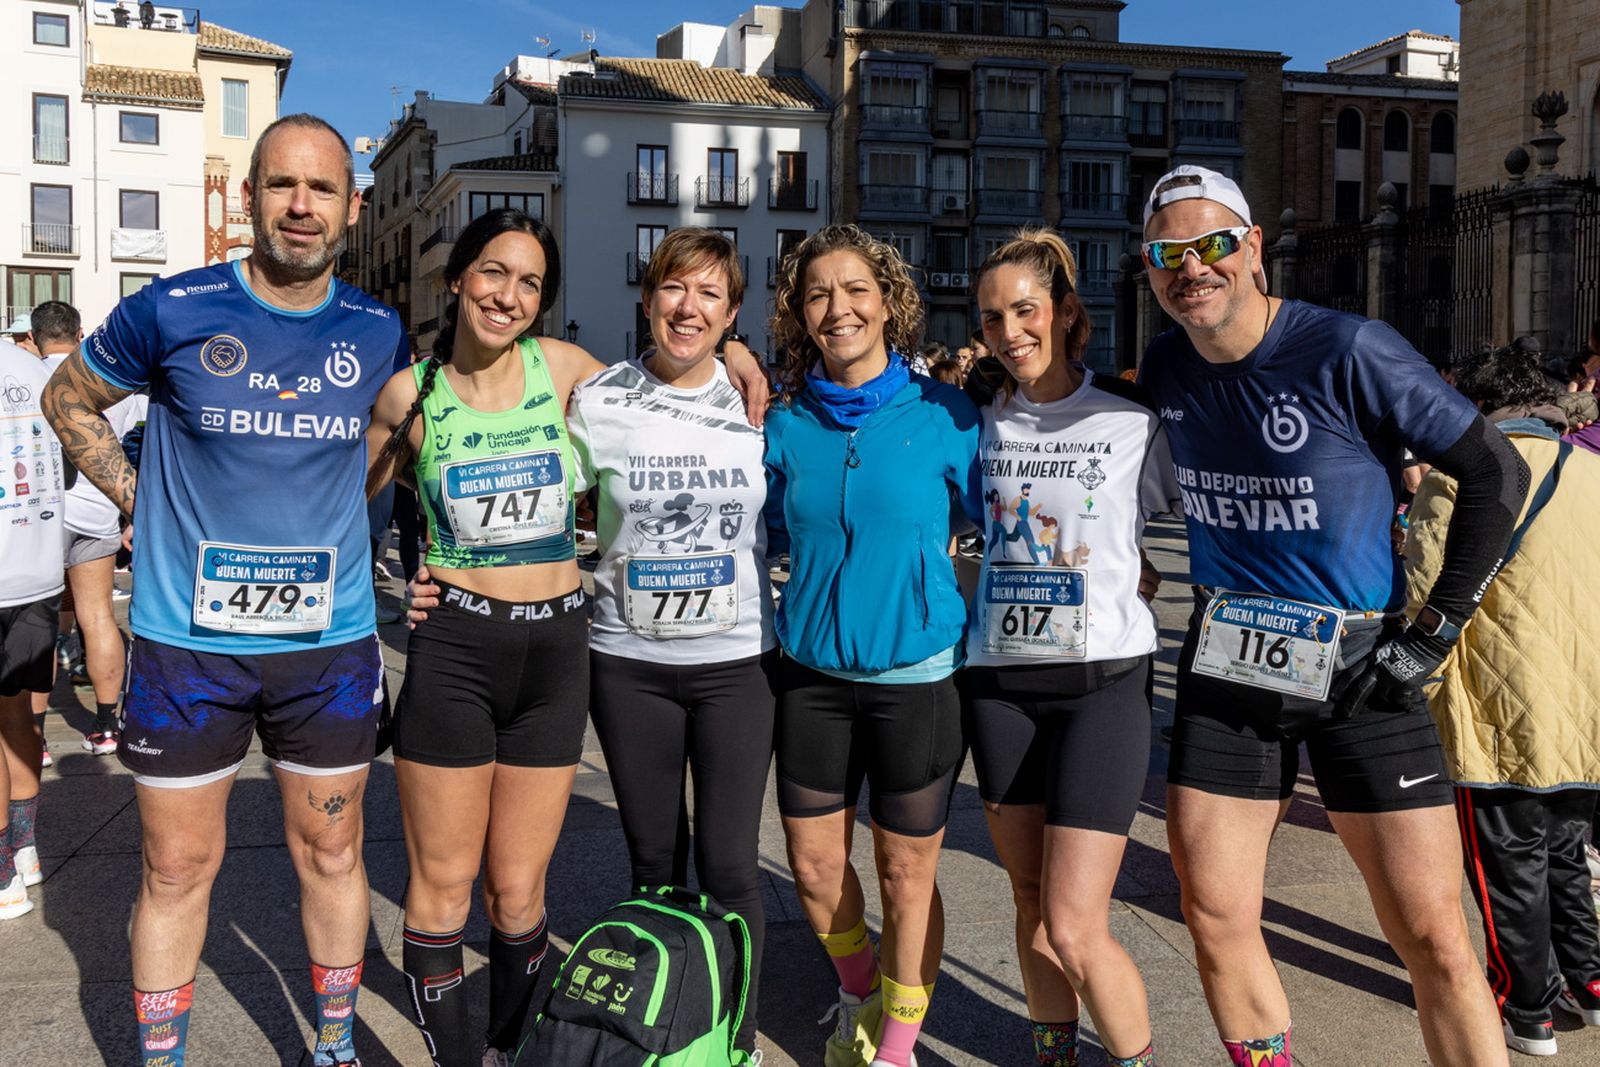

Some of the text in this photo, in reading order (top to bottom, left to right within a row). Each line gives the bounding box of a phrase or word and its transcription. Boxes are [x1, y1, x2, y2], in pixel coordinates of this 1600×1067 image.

[187, 281, 229, 293] neumax
[249, 373, 321, 393] RA 28
[1161, 406, 1184, 421] vive
[201, 409, 361, 440] CD BULEVAR
[486, 424, 542, 441] Fundación
[488, 436, 531, 449] Unicaja
[993, 440, 1040, 453] CARRERA
[1045, 442, 1112, 454] CAMINATA
[459, 458, 549, 477] VI CARRERA CAMINATA
[629, 455, 707, 468] VII CARRERA
[1016, 460, 1077, 478] MUERTE
[460, 472, 534, 494] BUENA MUERTE
[629, 468, 750, 492] URBANA
[1172, 462, 1314, 495] LUB DEPORTIVO
[477, 490, 542, 527] 747
[229, 553, 270, 564] CARRERA
[273, 555, 317, 564] CAMINATA
[638, 559, 724, 571] VI CARRERA CAMINATA
[216, 565, 296, 580] BUENA MUERTE
[638, 573, 707, 587] BUENA MUERTE
[1000, 574, 1028, 583] CARRERA
[1029, 574, 1071, 585] CAMINATA
[228, 584, 301, 614] 479
[446, 588, 492, 616] FILA
[991, 587, 1052, 601] BUENA MUERTE
[510, 603, 554, 621] FILA
[652, 589, 713, 620] 777
[1230, 596, 1322, 619] VI CARRERA CAMINATA
[1002, 605, 1054, 636] 617
[1222, 607, 1299, 632] BUENA MUERTE
[1239, 629, 1289, 669] 116
[322, 975, 356, 987] CALM
[141, 989, 178, 1003] KEEP
[140, 998, 177, 1012] CALM
[146, 1008, 174, 1021] RUN
[150, 1021, 172, 1035] JUST
